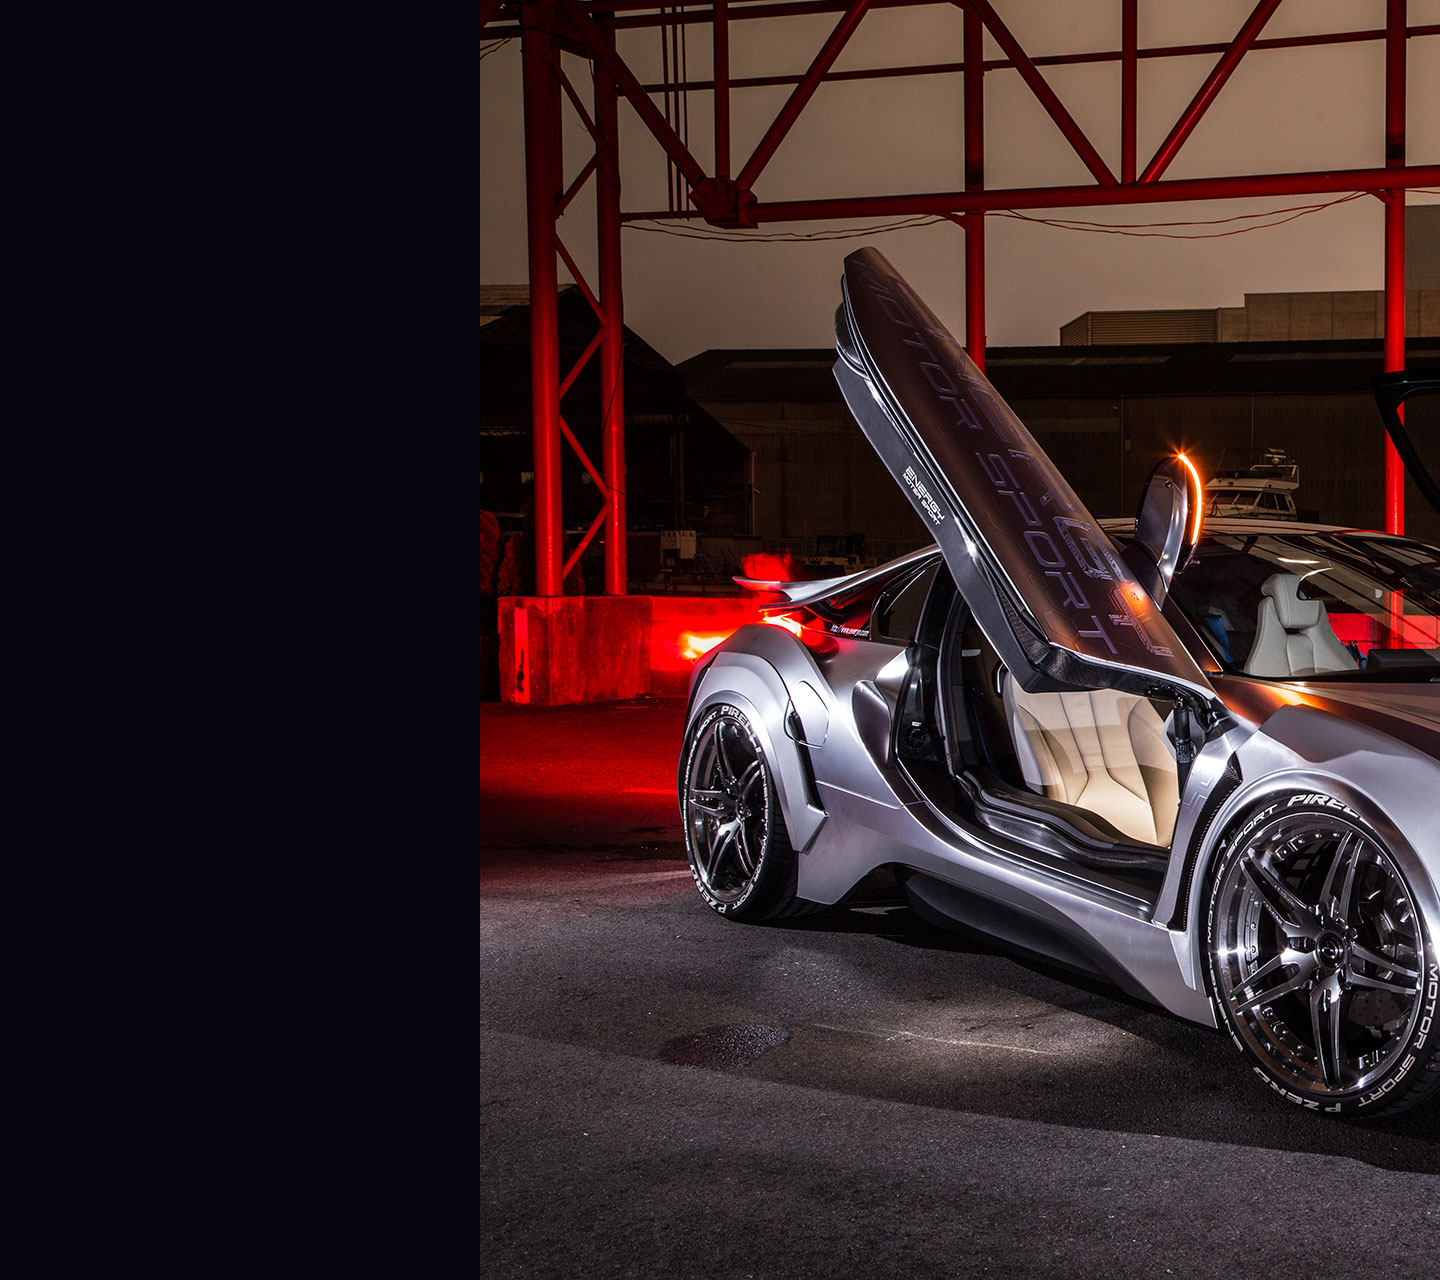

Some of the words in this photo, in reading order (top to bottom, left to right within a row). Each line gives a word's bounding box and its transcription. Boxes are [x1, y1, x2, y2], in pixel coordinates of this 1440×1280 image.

[851, 258, 984, 431] MOTOR
[975, 451, 1120, 655] SPORT
[905, 465, 946, 521] ENERGY
[920, 499, 941, 526] SPORT
[720, 705, 762, 753] PIRELLI
[1207, 863, 1226, 943] MOTOR
[1226, 804, 1278, 860] SPORT
[1413, 962, 1439, 1050] MOTOR
[1252, 1065, 1320, 1111] ZERO
[1357, 1053, 1417, 1108] SPORT
